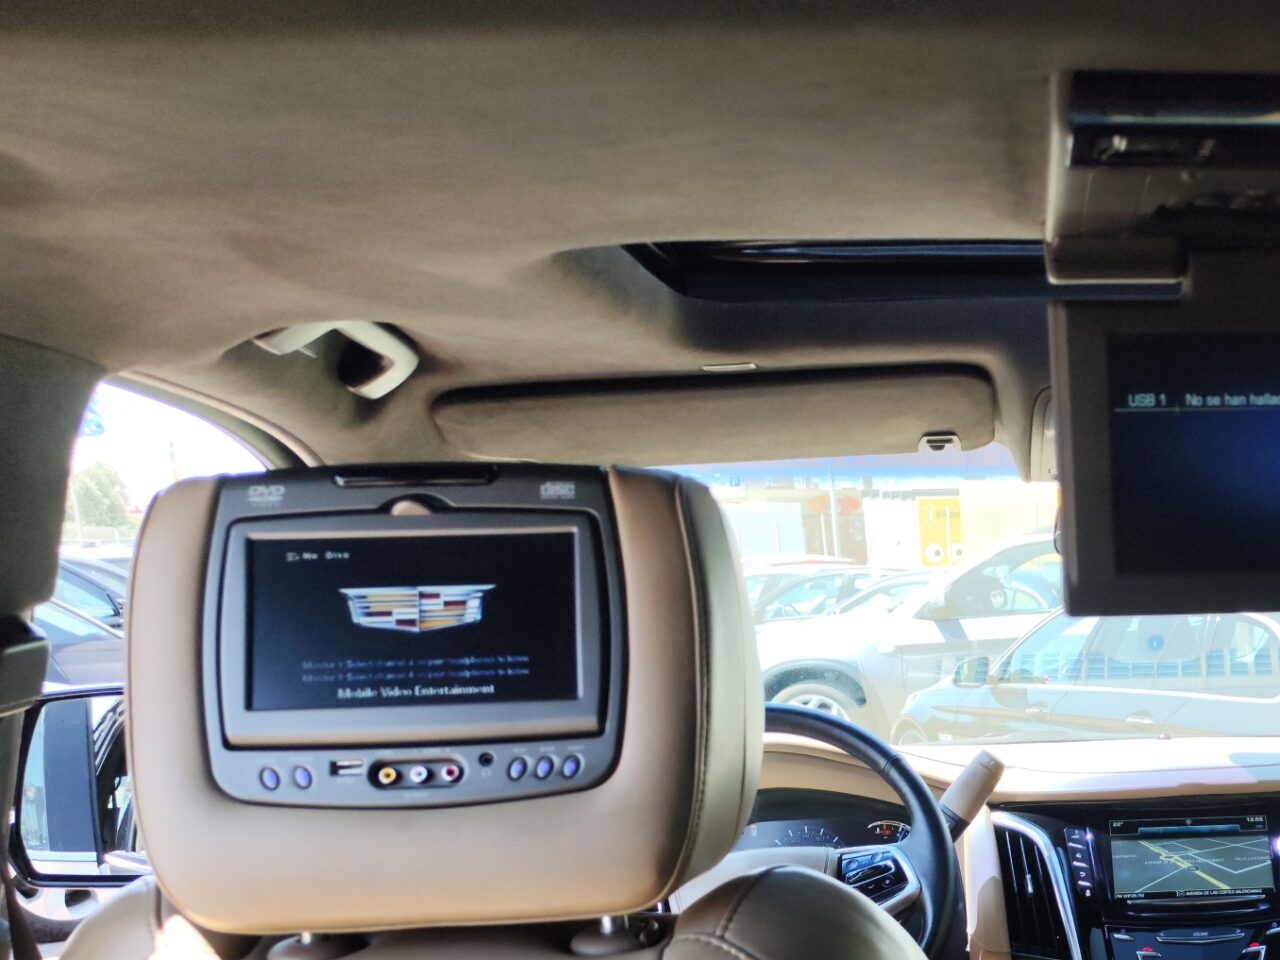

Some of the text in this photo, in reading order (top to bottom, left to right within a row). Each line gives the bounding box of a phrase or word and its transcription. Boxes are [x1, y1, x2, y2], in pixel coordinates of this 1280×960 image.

[1127, 393, 1167, 407] USB 1
[1185, 393, 1203, 406] No
[1206, 395, 1221, 406] se
[1224, 393, 1246, 406] han
[337, 684, 495, 699] Mobile Video Entertainment
